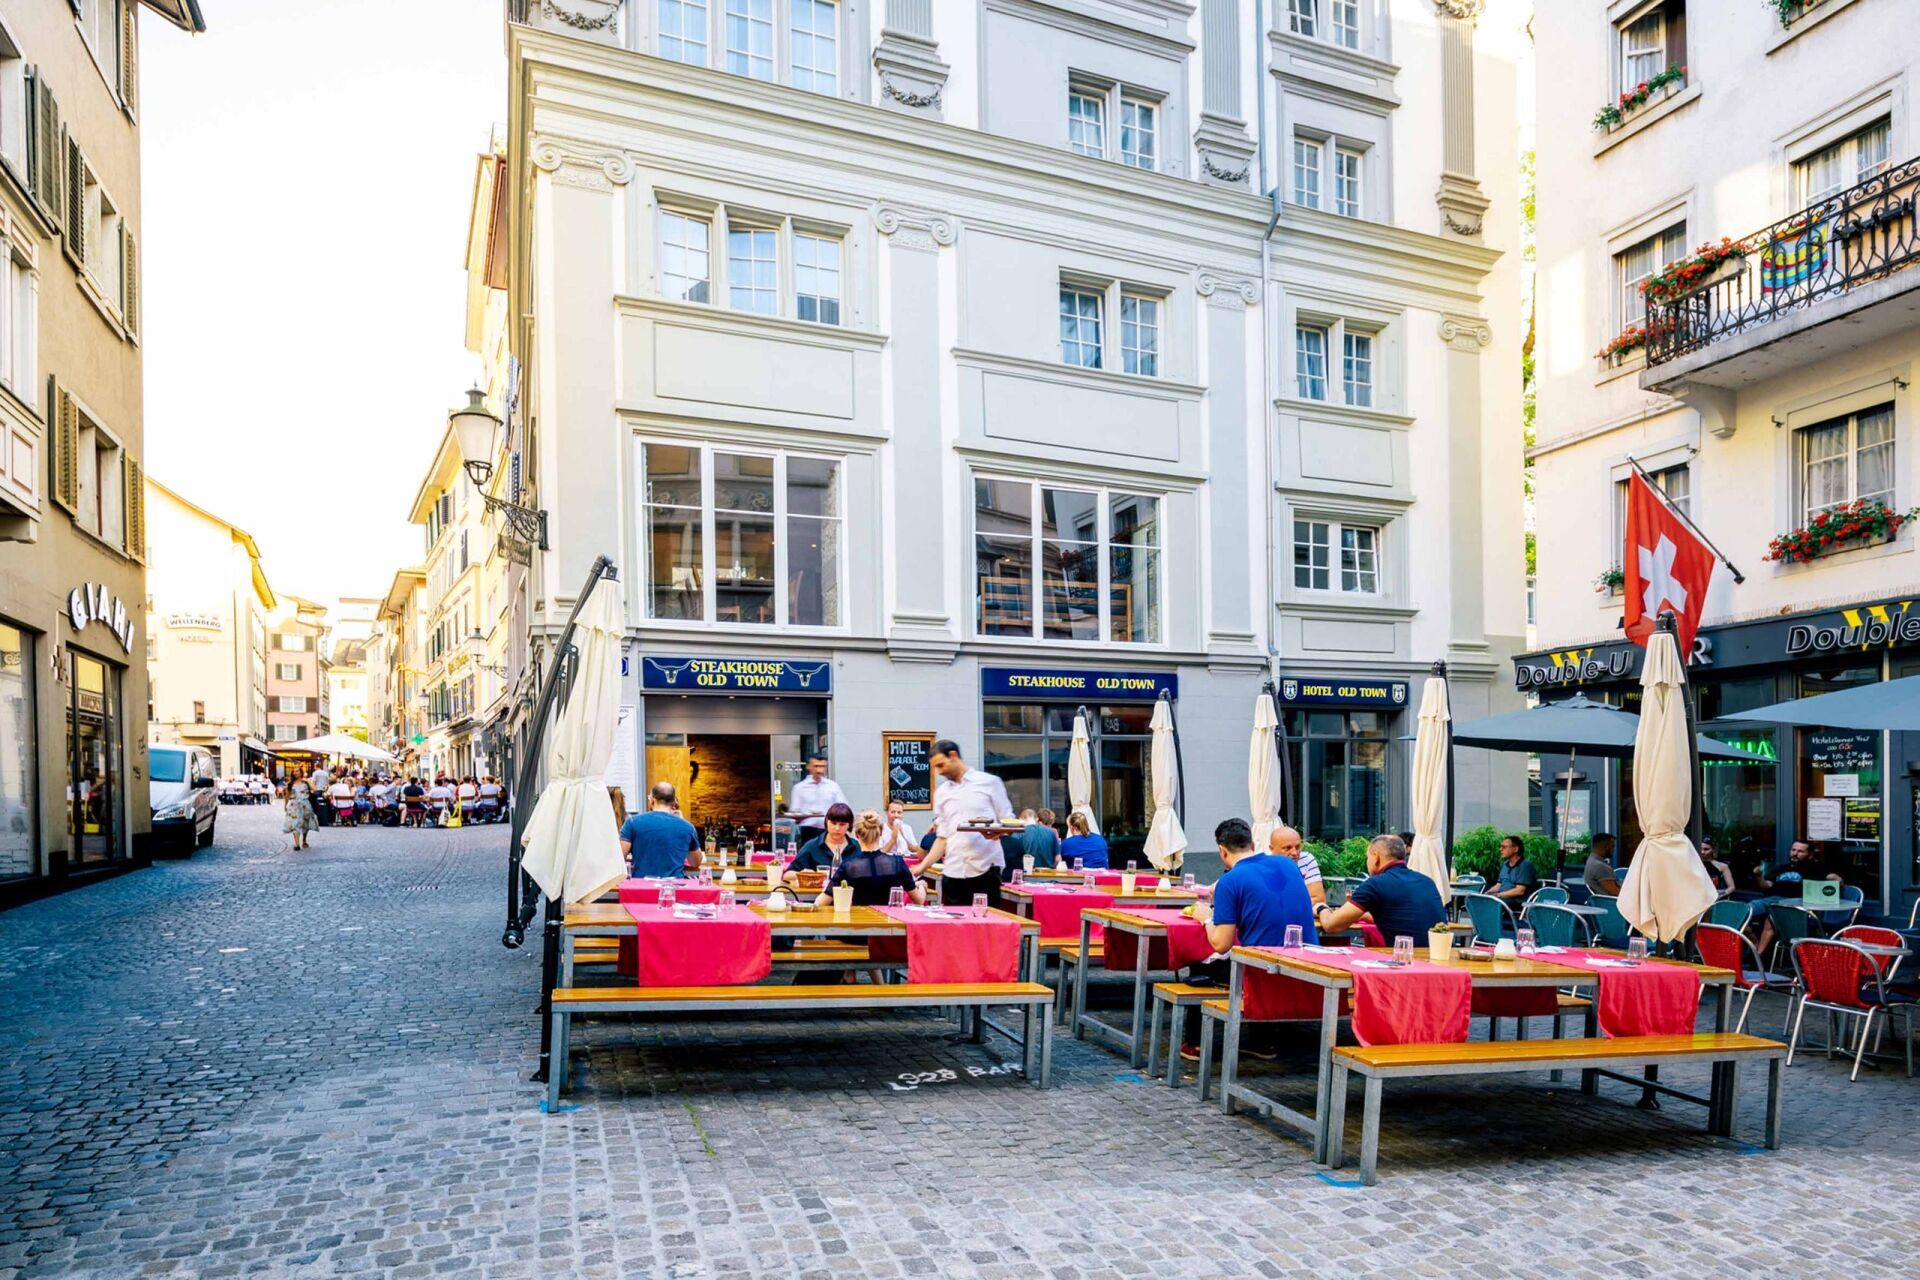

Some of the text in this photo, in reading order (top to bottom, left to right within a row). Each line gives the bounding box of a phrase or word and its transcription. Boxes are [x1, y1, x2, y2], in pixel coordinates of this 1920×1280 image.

[68, 582, 134, 655] GIAHI
[169, 618, 221, 628] WELLENBERG
[690, 660, 784, 675] STEAKHOUSE
[1515, 650, 1632, 687] Double-U
[696, 674, 779, 688] OLD TOWN
[1009, 675, 1155, 690] STEAKHOUSE OLD TOWN
[1302, 685, 1387, 698] HOTEL OLD TOWN
[890, 741, 926, 755] HOTEL
